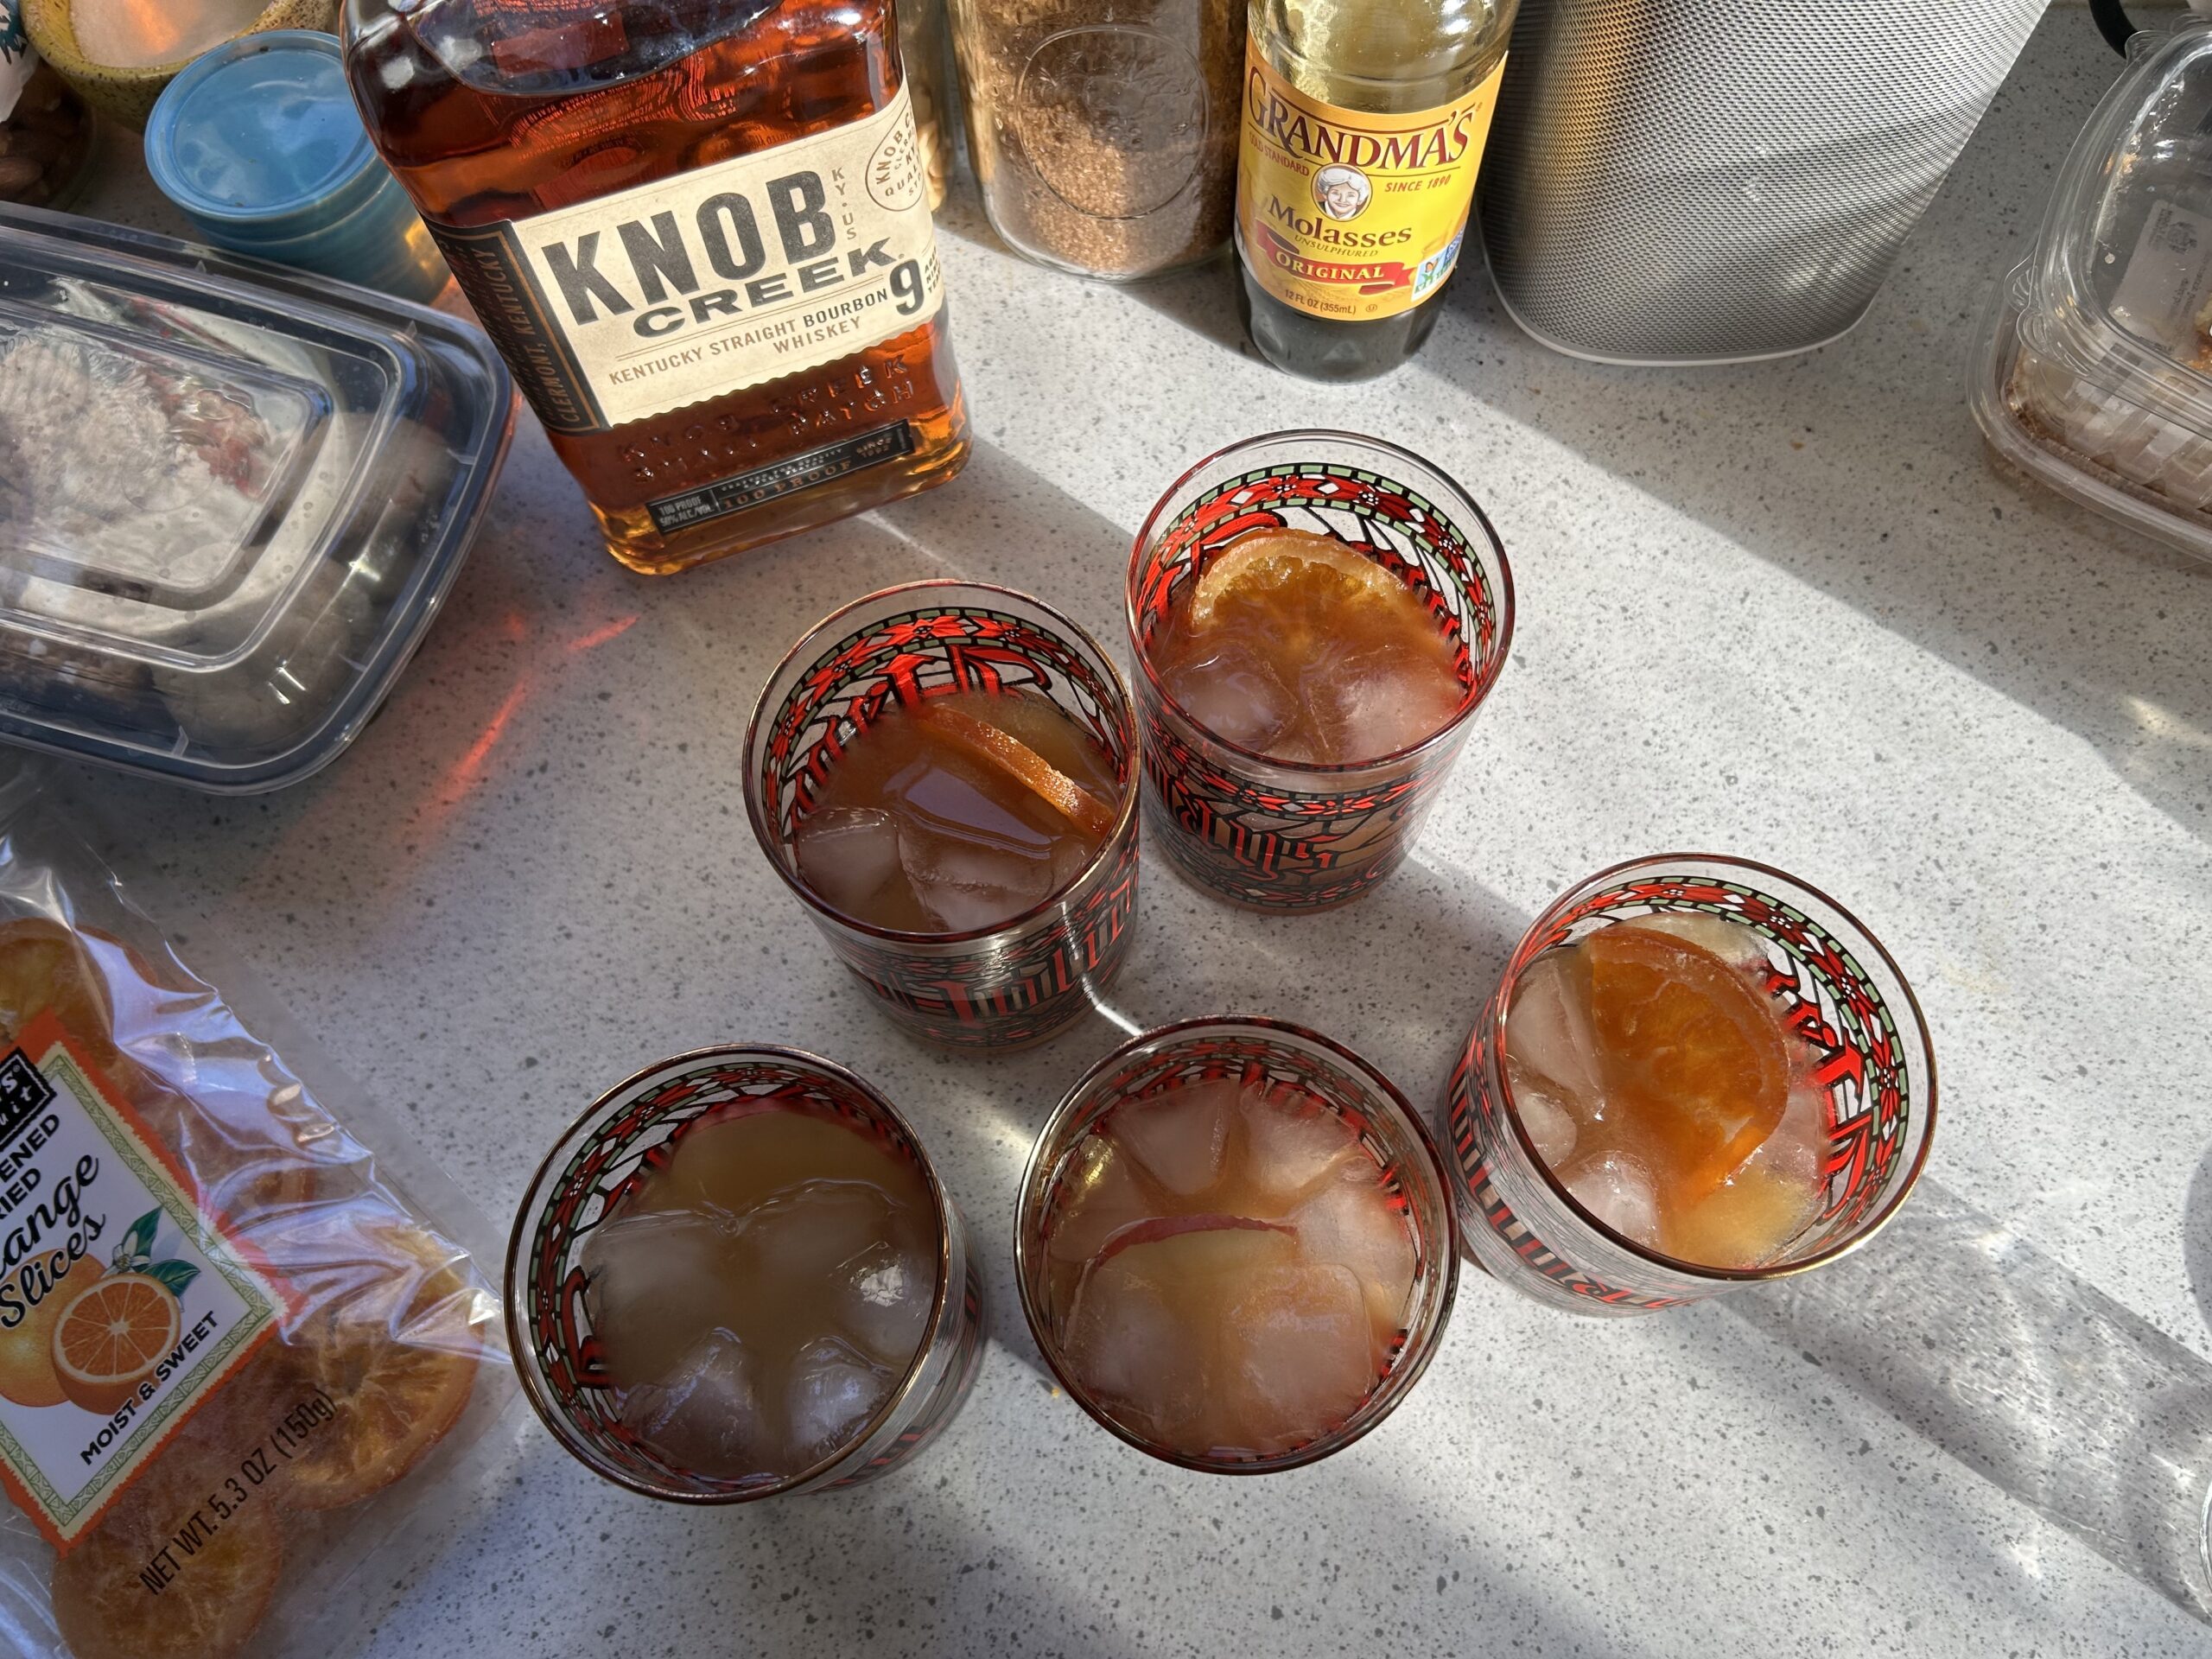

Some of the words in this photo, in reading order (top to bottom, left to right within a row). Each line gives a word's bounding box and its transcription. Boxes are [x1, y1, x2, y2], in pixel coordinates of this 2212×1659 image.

[1249, 66, 1472, 170] GRANDMA'S
[875, 130, 903, 185] KNOB
[1265, 145, 1309, 176] STANDARD
[1384, 180, 1421, 193] SINCE
[1427, 175, 1450, 189] 1890
[542, 170, 836, 325] KNOB
[1268, 194, 1412, 248] Molasses
[1294, 235, 1379, 257] UNSULPHURED
[472, 248, 536, 336] KENTUCKY
[632, 237, 897, 338] CREEK
[890, 258, 925, 315] 9
[1275, 251, 1384, 279] ORIGINAL
[1285, 289, 1294, 301] 12
[1295, 294, 1305, 305] FL
[1307, 298, 1319, 308] OZ
[1320, 302, 1356, 315] (355mL)
[609, 346, 702, 385] KENTUCKY
[709, 319, 798, 355] STRAIGHT
[804, 289, 887, 327] BOURBON
[773, 316, 861, 353] WHISKEY
[723, 489, 766, 509] 100
[773, 459, 852, 492] PROOF
[0, 1114, 60, 1183] ENED
[0, 1167, 41, 1220] IED
[0, 1154, 99, 1282] ange
[0, 1213, 105, 1328] Slices
[79, 1399, 137, 1465] MOIST
[138, 1382, 156, 1402] &
[155, 1310, 219, 1382] SWEET
[138, 1545, 182, 1596] NET
[173, 1510, 219, 1556] WT.
[207, 1477, 248, 1520] 5.3
[240, 1447, 277, 1487] OZ
[269, 1389, 339, 1459] (150g)
